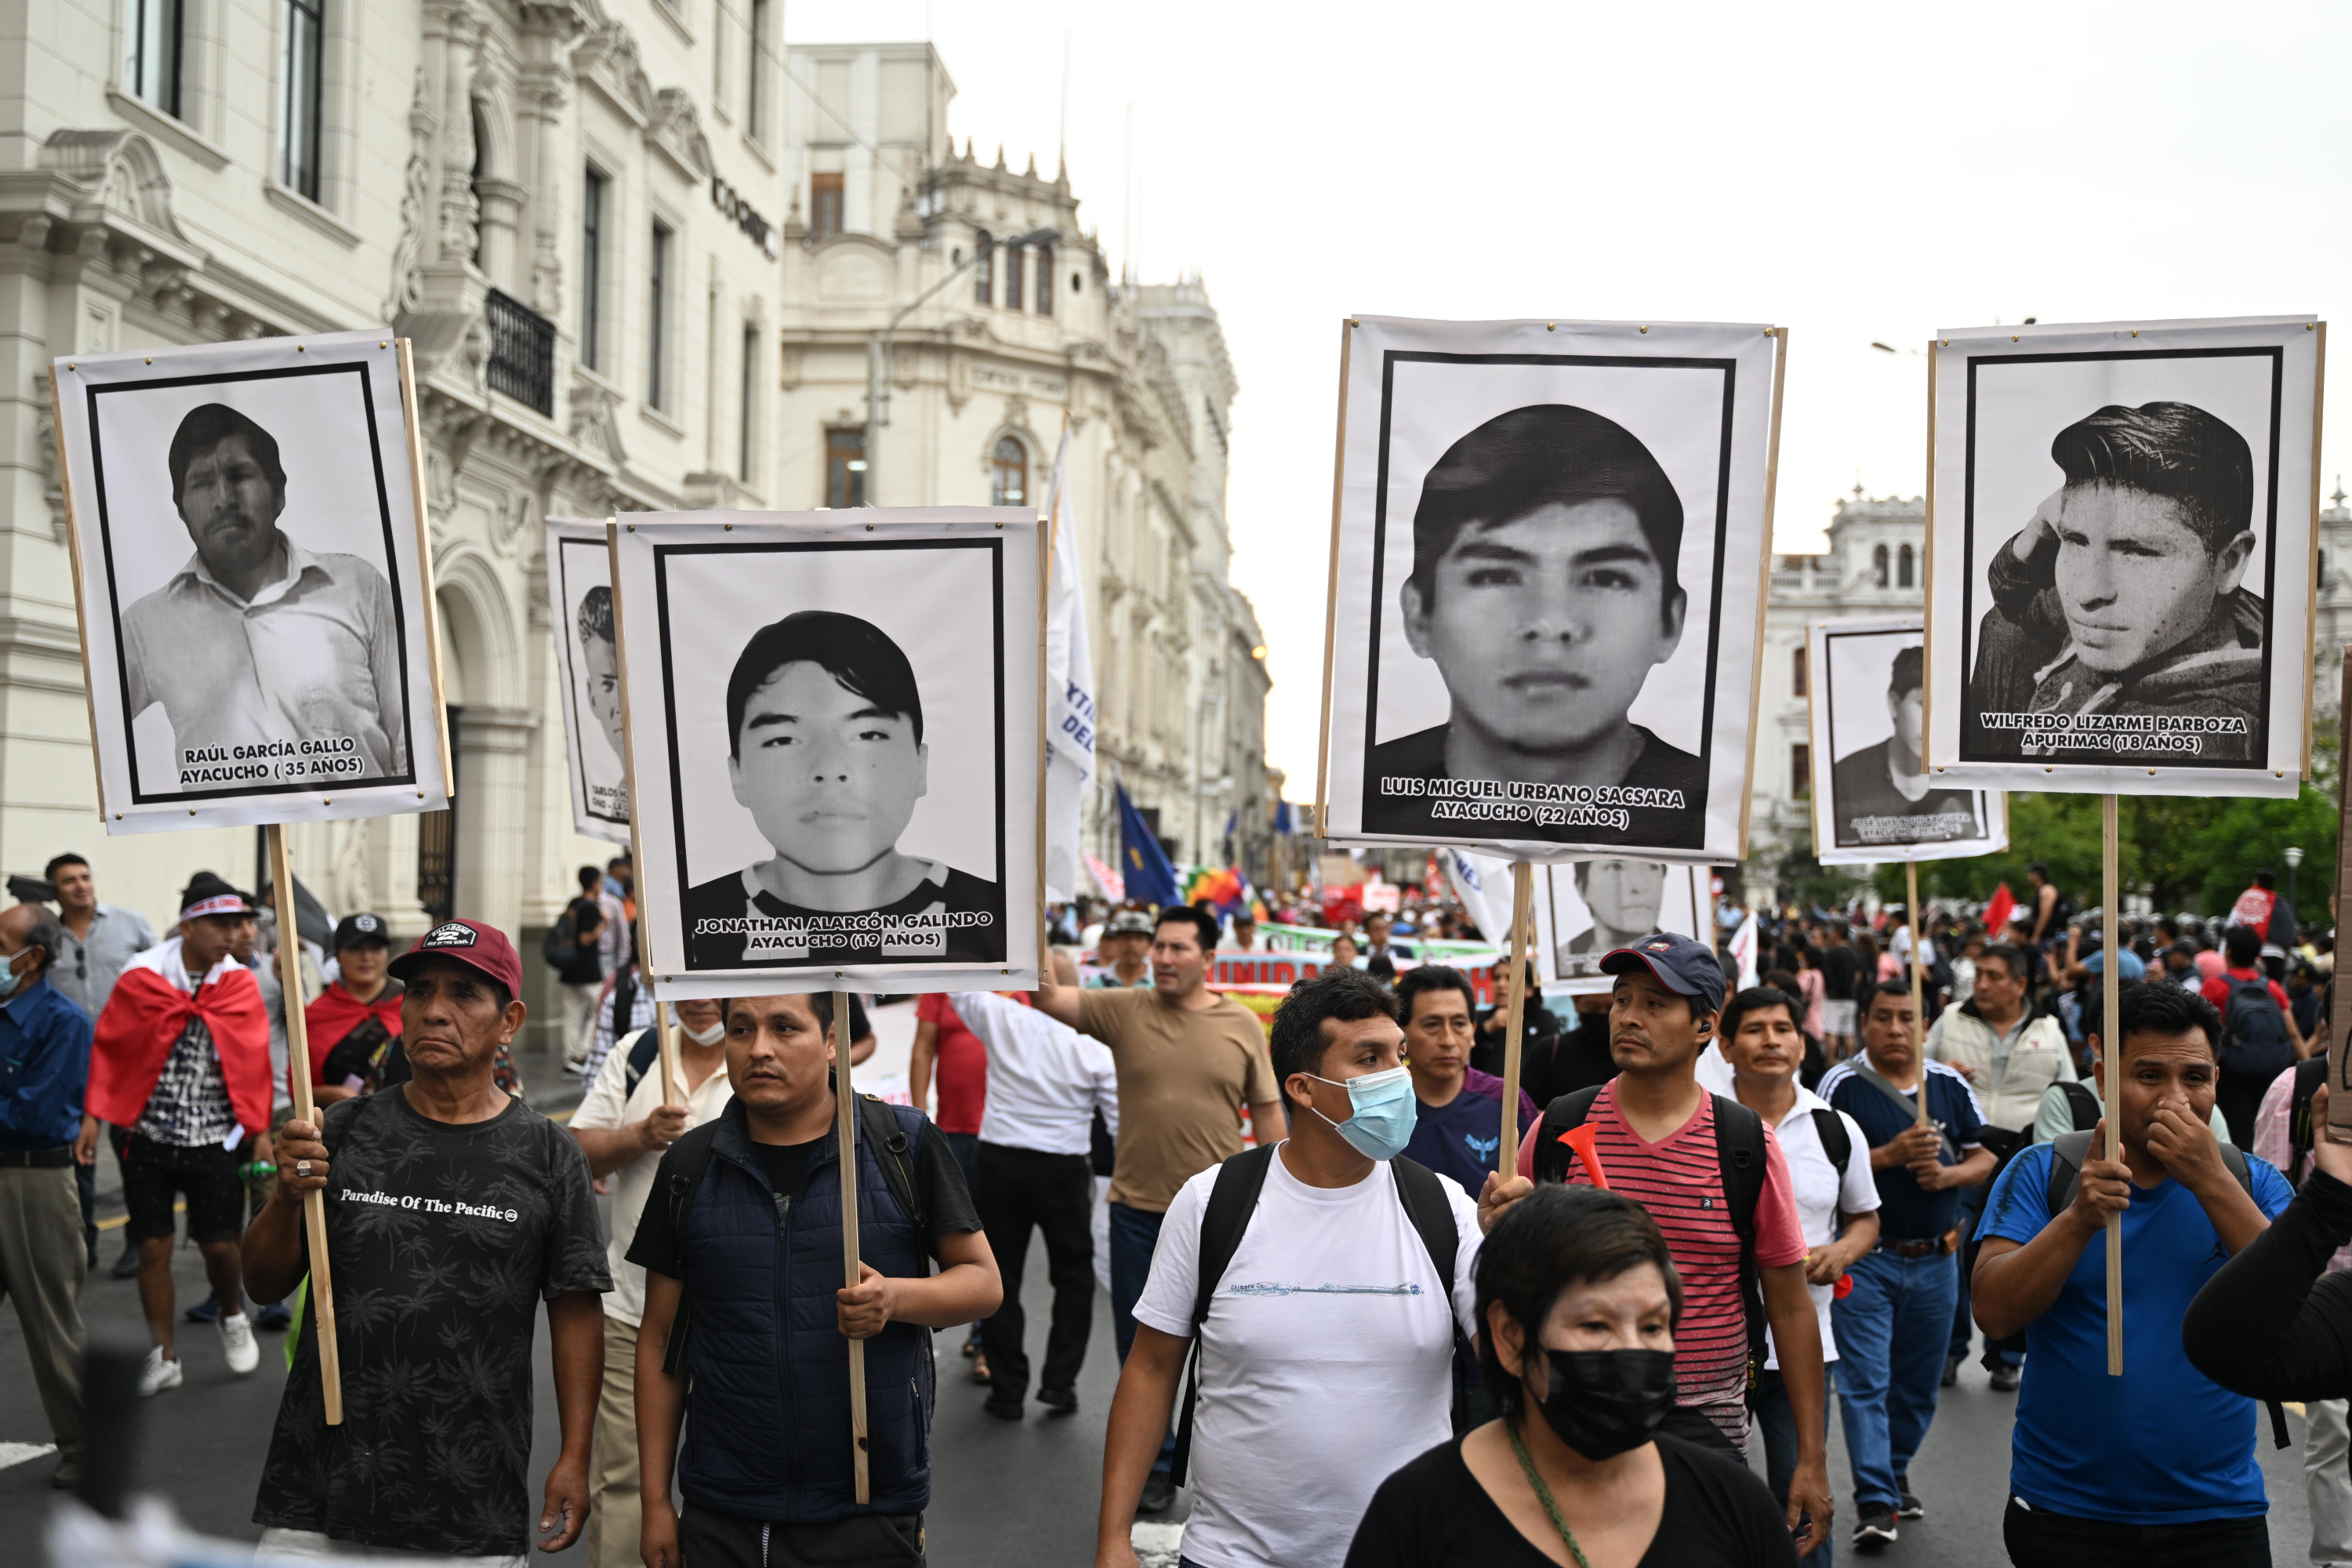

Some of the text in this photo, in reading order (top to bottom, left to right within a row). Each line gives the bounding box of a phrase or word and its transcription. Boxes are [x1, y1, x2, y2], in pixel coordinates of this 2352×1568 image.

[1980, 713, 2247, 733] WILFREDO LIZARME BARBOZA
[185, 738, 354, 764] RAÚL GARCÍA GALLO
[2021, 731, 2203, 754] APURIMAC (18 AÑOS)
[180, 764, 269, 784] AYACUCHO
[310, 756, 365, 775] AÑOS)
[1381, 777, 1685, 808] LUIS MIGUEL URBANO SACSARA
[1432, 801, 1630, 831] AYACUCHO (22 AÑOS)
[432, 925, 470, 937] BILLABONG
[696, 912, 993, 935] JONATHAN ALARCÓN GALINDO
[750, 931, 941, 949] AYACUCHO (19 AÑOS)
[340, 1189, 398, 1207] Paradise
[401, 1196, 422, 1210] Of
[424, 1198, 452, 1213] The
[455, 1202, 503, 1220] Pacific
